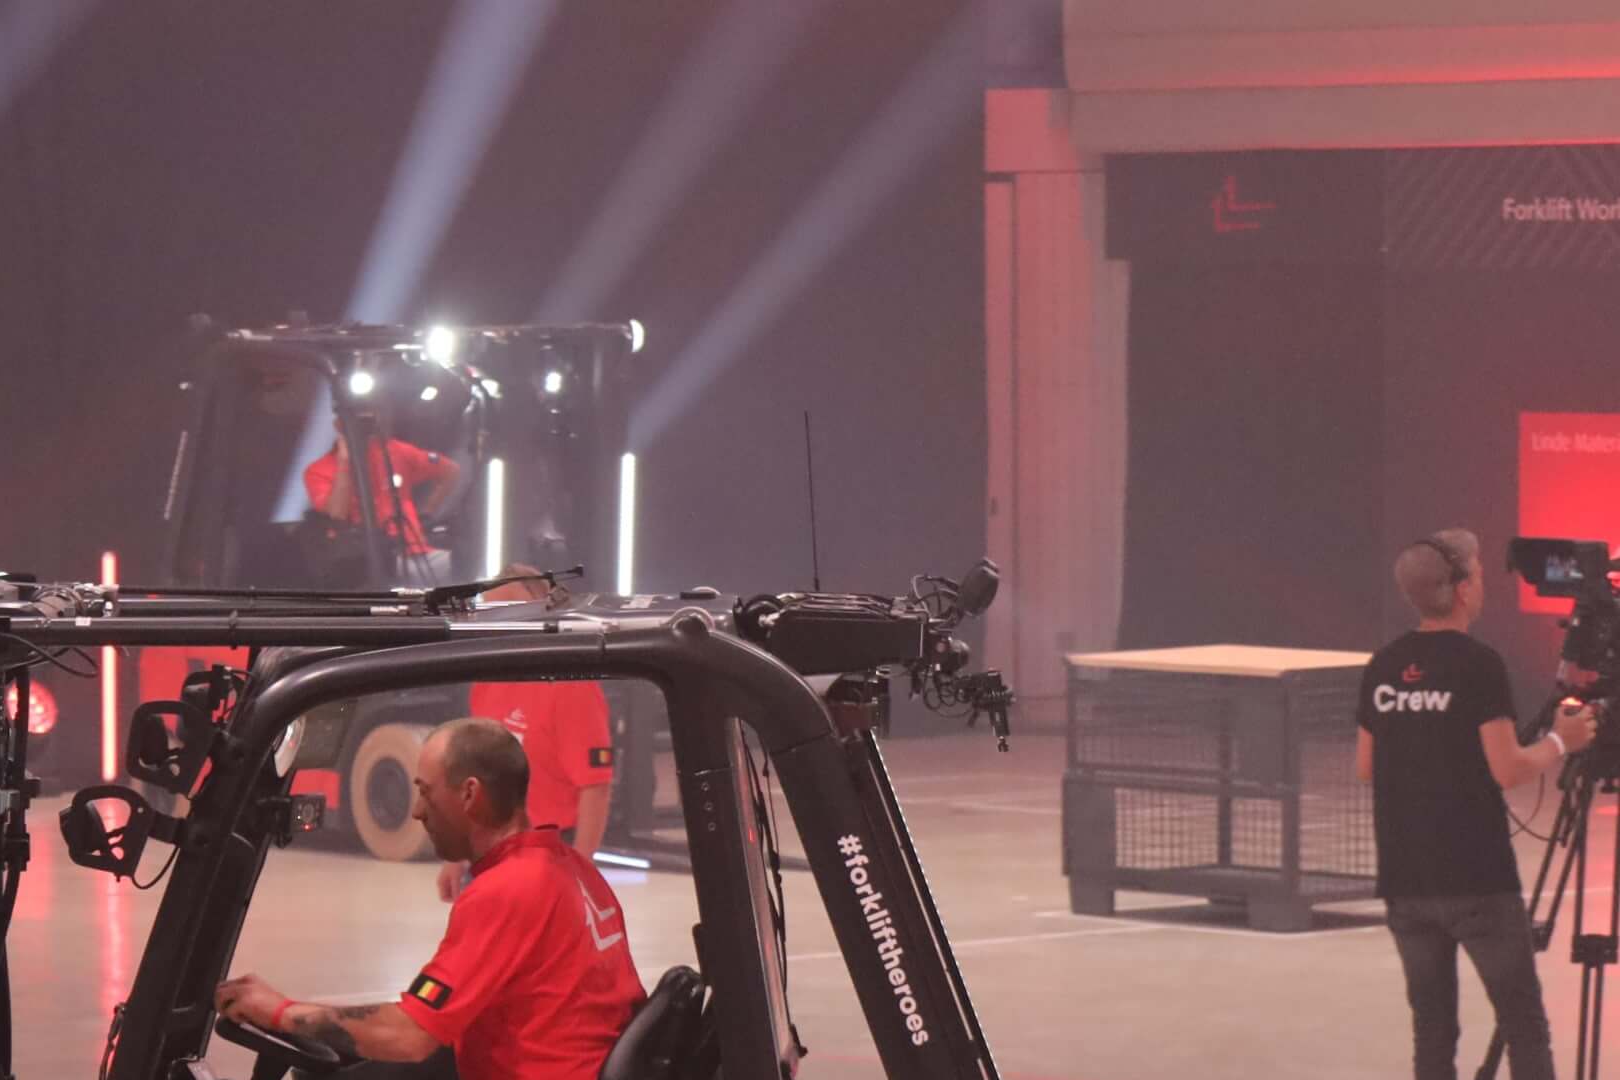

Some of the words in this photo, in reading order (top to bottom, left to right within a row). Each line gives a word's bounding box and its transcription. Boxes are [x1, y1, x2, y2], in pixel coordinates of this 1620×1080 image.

[1502, 197, 1572, 221] Forklift
[1373, 684, 1452, 713] Crew
[837, 833, 929, 1047] #forkliftheroes
